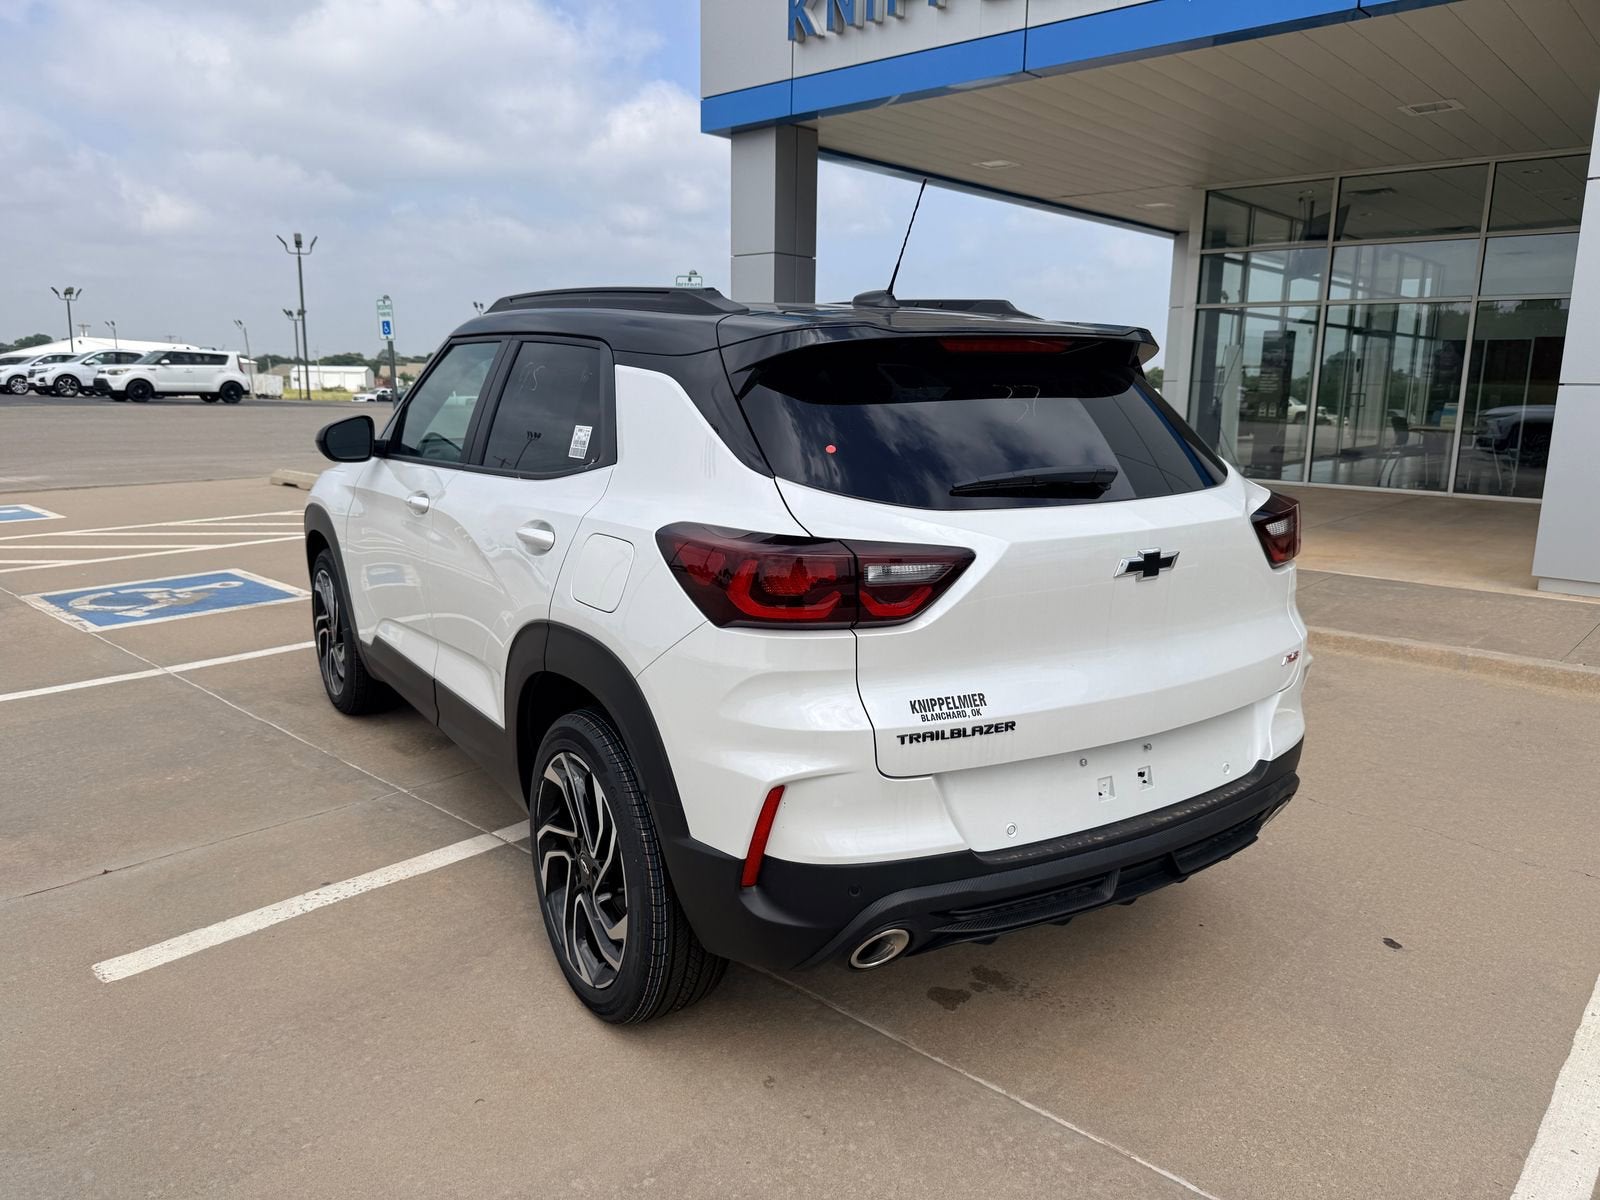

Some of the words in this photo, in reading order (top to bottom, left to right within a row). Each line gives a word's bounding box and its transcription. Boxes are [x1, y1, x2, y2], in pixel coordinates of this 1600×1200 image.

[909, 692, 988, 714] KNIPPELMIER
[920, 710, 971, 722] BLANCHARD,
[971, 708, 982, 717] OK
[896, 720, 1017, 745] TRAILBLAZER
